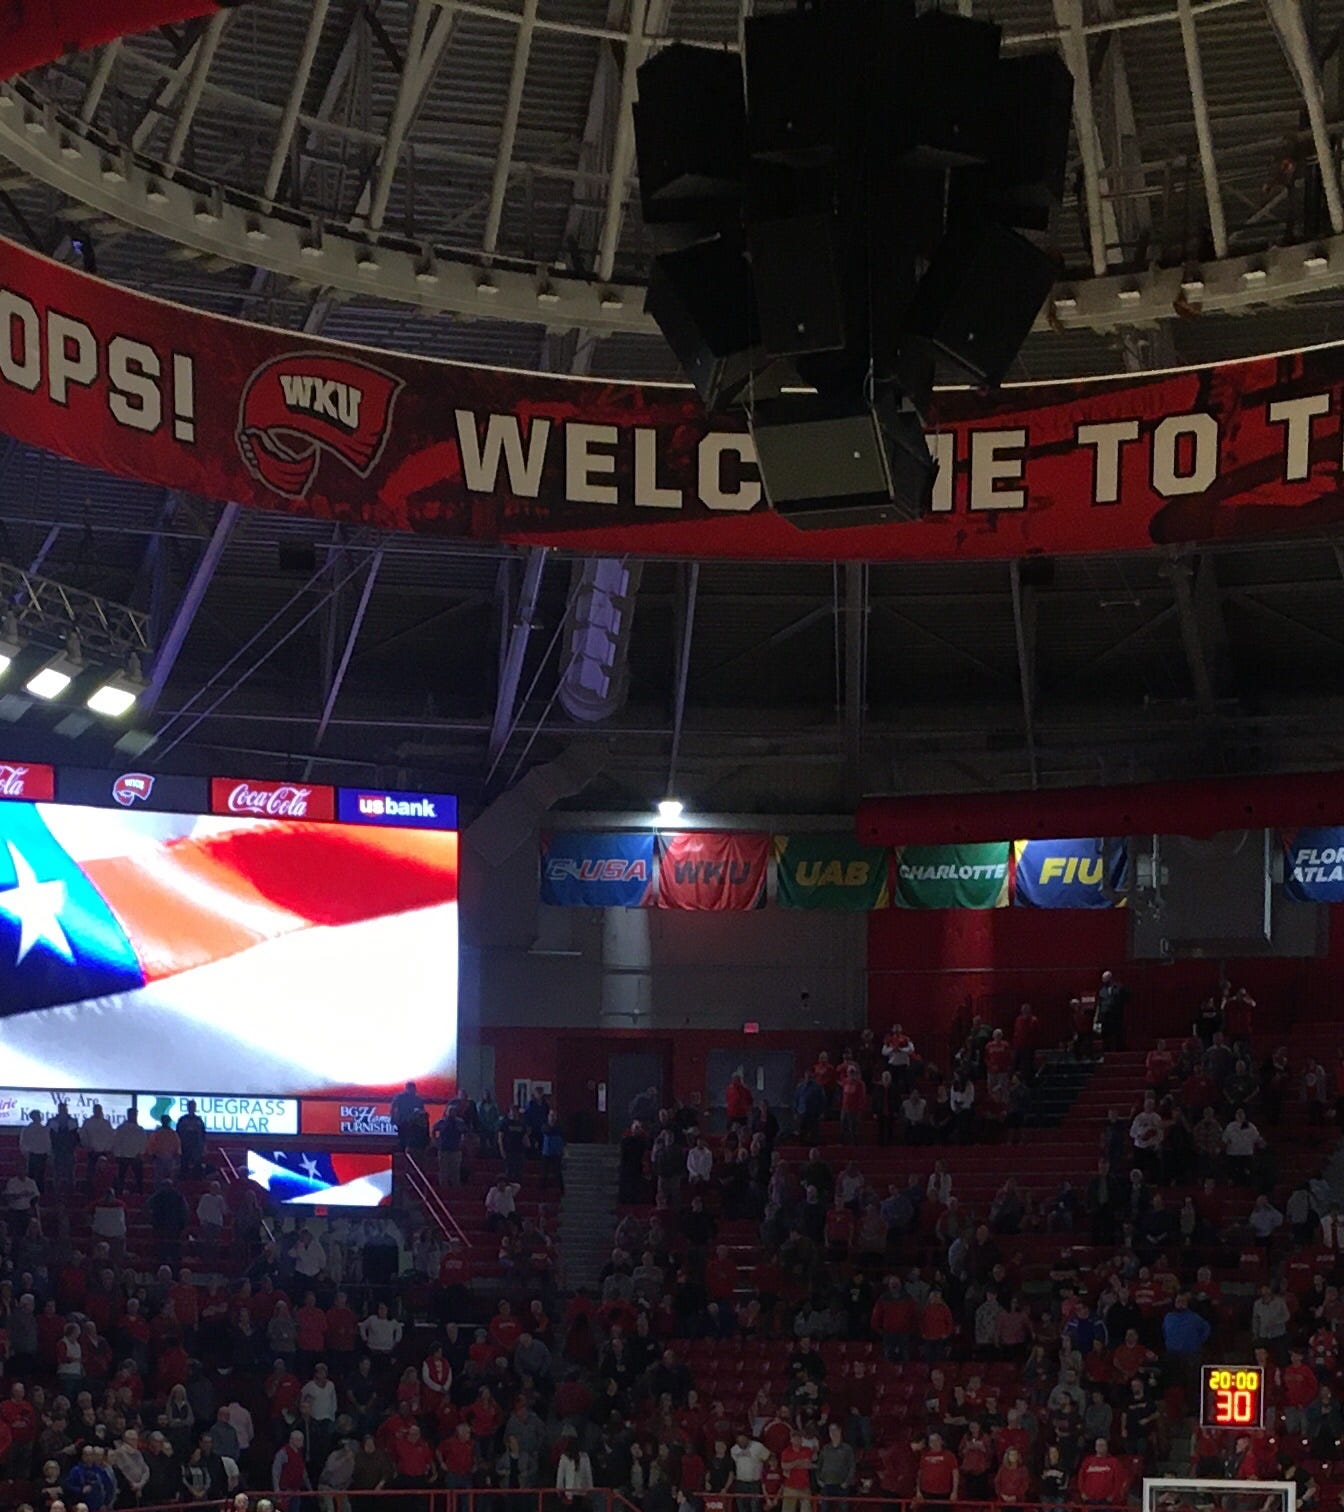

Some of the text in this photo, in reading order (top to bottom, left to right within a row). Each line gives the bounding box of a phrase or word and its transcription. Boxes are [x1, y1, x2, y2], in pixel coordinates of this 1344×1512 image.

[279, 375, 362, 429] WKU
[455, 409, 1027, 512] WELCE
[1076, 412, 1219, 503] TO
[673, 861, 751, 885] WKU
[795, 860, 870, 886] UAB
[899, 863, 1006, 880] CHARLOTTE
[1038, 858, 1104, 885] FIU
[1208, 1371, 1258, 1391] 20:00
[1216, 1391, 1251, 1422] 30
